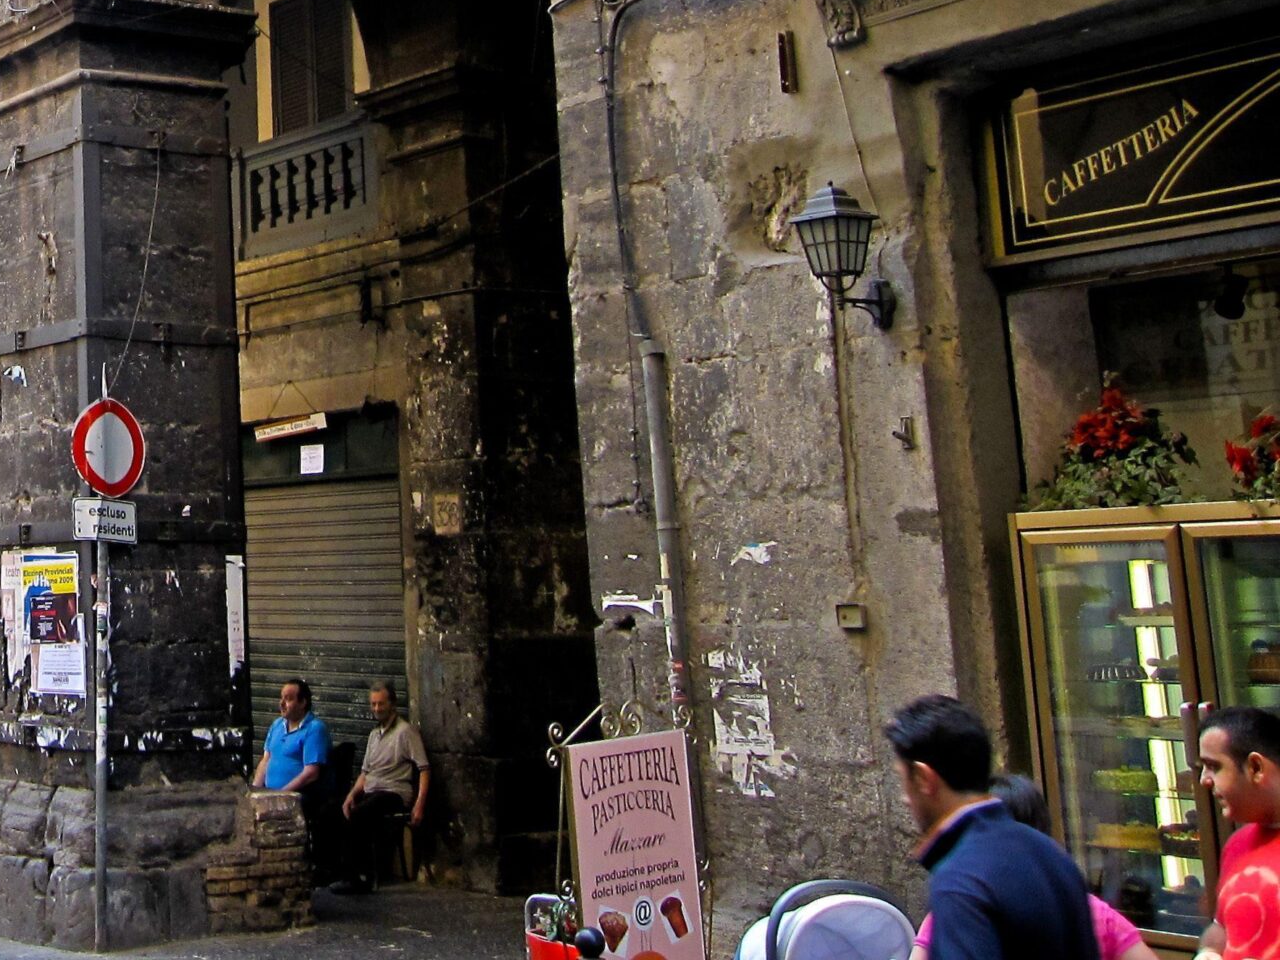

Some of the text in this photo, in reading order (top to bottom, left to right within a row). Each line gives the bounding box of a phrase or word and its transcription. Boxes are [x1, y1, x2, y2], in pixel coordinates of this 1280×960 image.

[1043, 98, 1200, 206] CAFFETTERIA
[88, 506, 127, 520] escluso
[93, 524, 135, 537] residenti
[579, 746, 681, 800] CAFFETTERIA
[592, 789, 676, 836] PASTICCERIA
[603, 827, 667, 856] Mazzaro
[591, 871, 685, 900] dolci tipici napoletani
[595, 858, 679, 886] produzione propria
